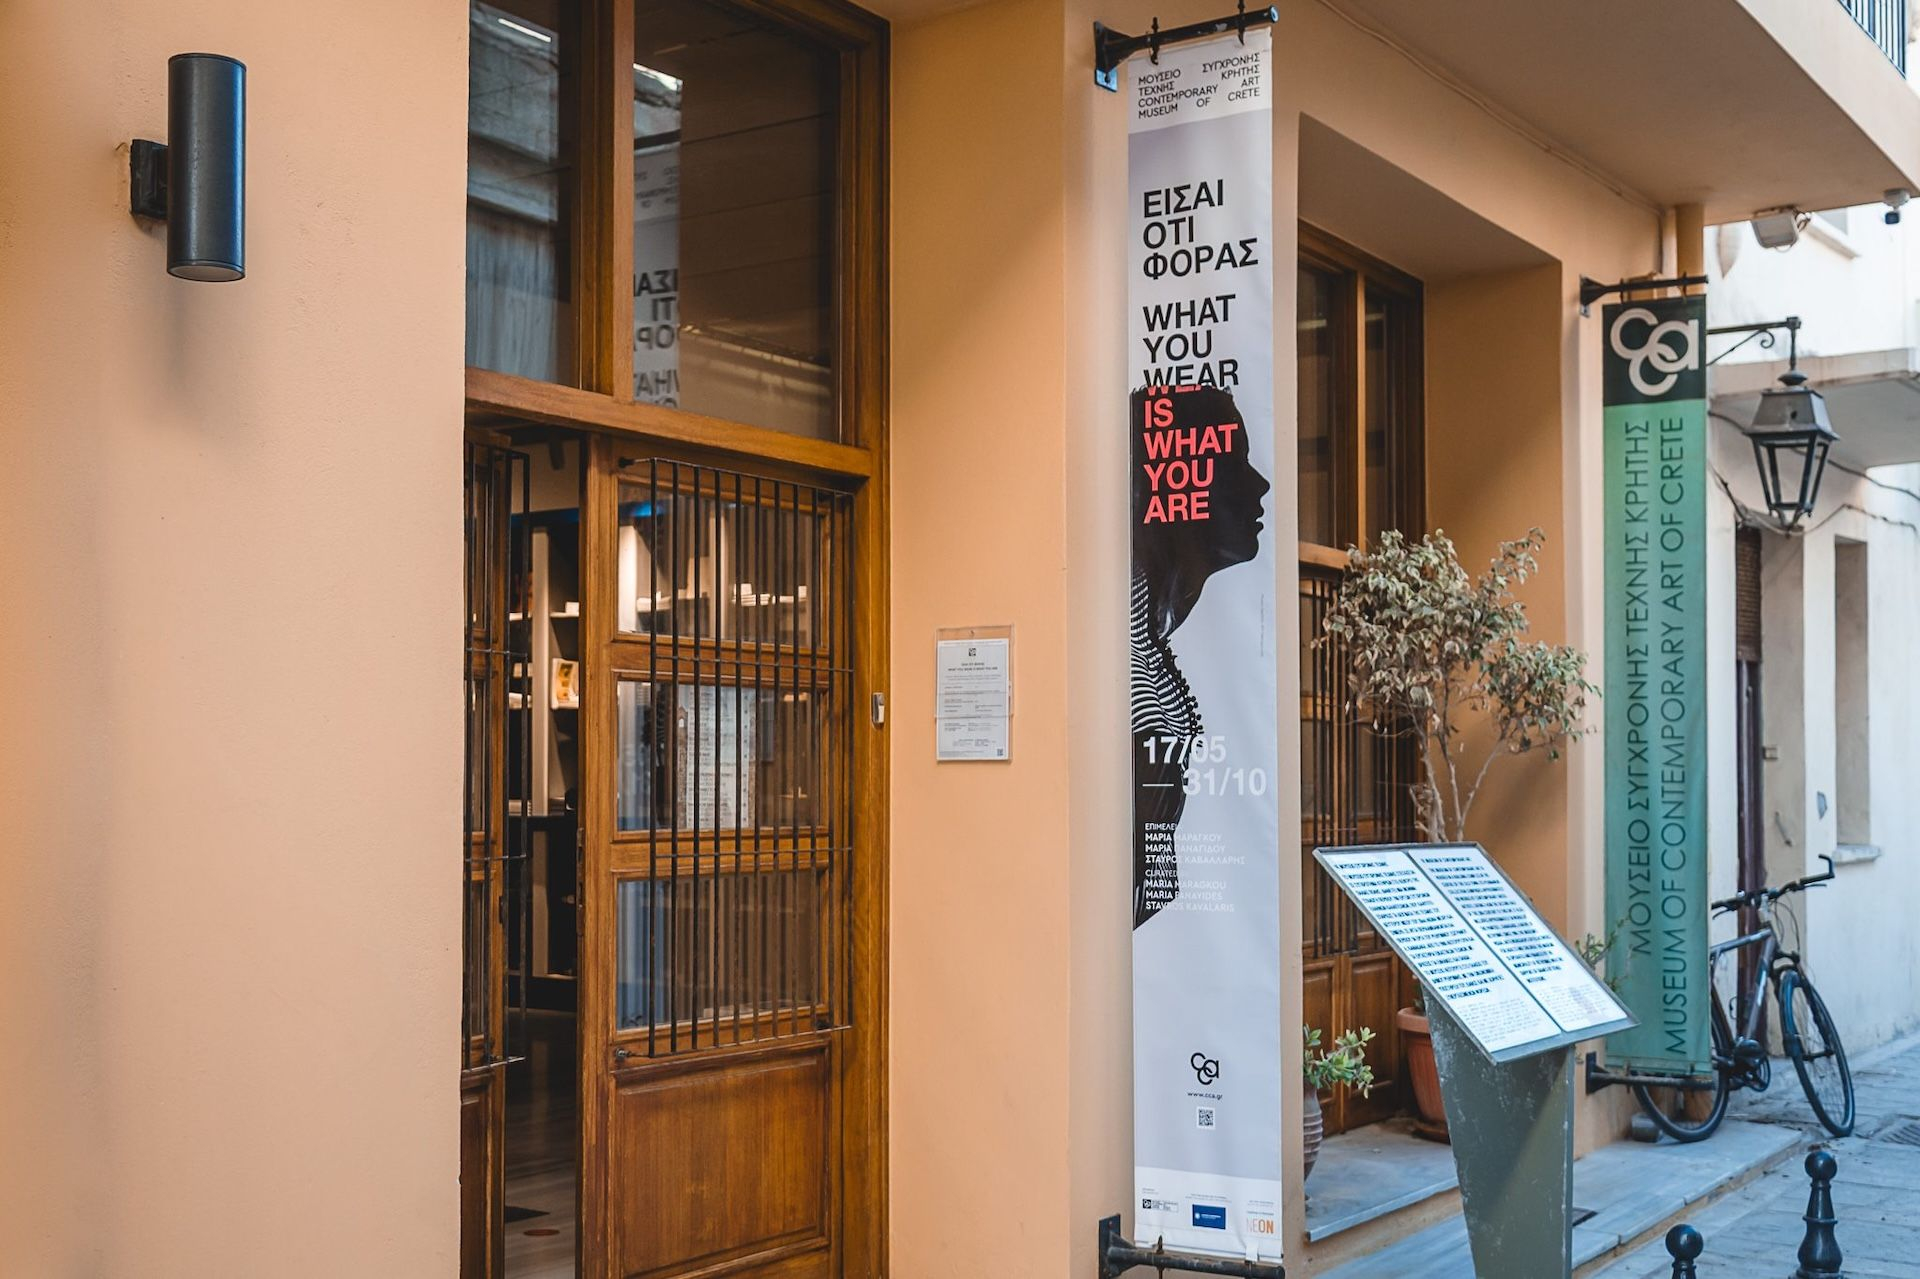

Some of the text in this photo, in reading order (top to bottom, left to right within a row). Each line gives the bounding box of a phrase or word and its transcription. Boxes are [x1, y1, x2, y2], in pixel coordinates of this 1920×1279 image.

[1138, 52, 1260, 85] ΜΟΥΣΕΙΟ ΣΥΓΧΡΟΝΗΣ
[1138, 64, 1260, 97] ΤΕΧΝΗΣ ΚΡΗΤΗΣ
[1138, 76, 1261, 108] CONTEMPORARY ART
[1138, 87, 1260, 119] MUSEUM OF CRETE
[1143, 179, 1224, 218] ΕΙΣΑΙ
[1143, 215, 1194, 249] ΟΤΙ
[1143, 237, 1259, 280] ΦΟΡΑΣ
[1143, 293, 1236, 332] WHAT
[1143, 329, 1212, 364] YOU
[1143, 358, 1240, 396] WEAR
[1144, 398, 1174, 429] IS
[1143, 423, 1239, 460] WHAT
[1143, 458, 1214, 492] YOU
[1143, 490, 1210, 524] ARE
[1625, 420, 1652, 955] ΜΟΥΣΕΙΟ ΣΥΓΧΡΟΝΗΣ ΤΕΧΝΗΣ ΚΡΗΤΗΣ
[1143, 734, 1227, 764] 17/05
[1660, 417, 1688, 1055] MUSEUM OF CONTEMPORARY ART OF CRETE
[1183, 767, 1267, 797] 31/10
[1144, 833, 1172, 842] ΜΑΡΙΑ
[1144, 844, 1172, 853] ΜΑΡΙΑ
[1145, 879, 1173, 889] MARIA
[1145, 890, 1173, 899] MARIA
[1246, 1218, 1275, 1234] NEON
